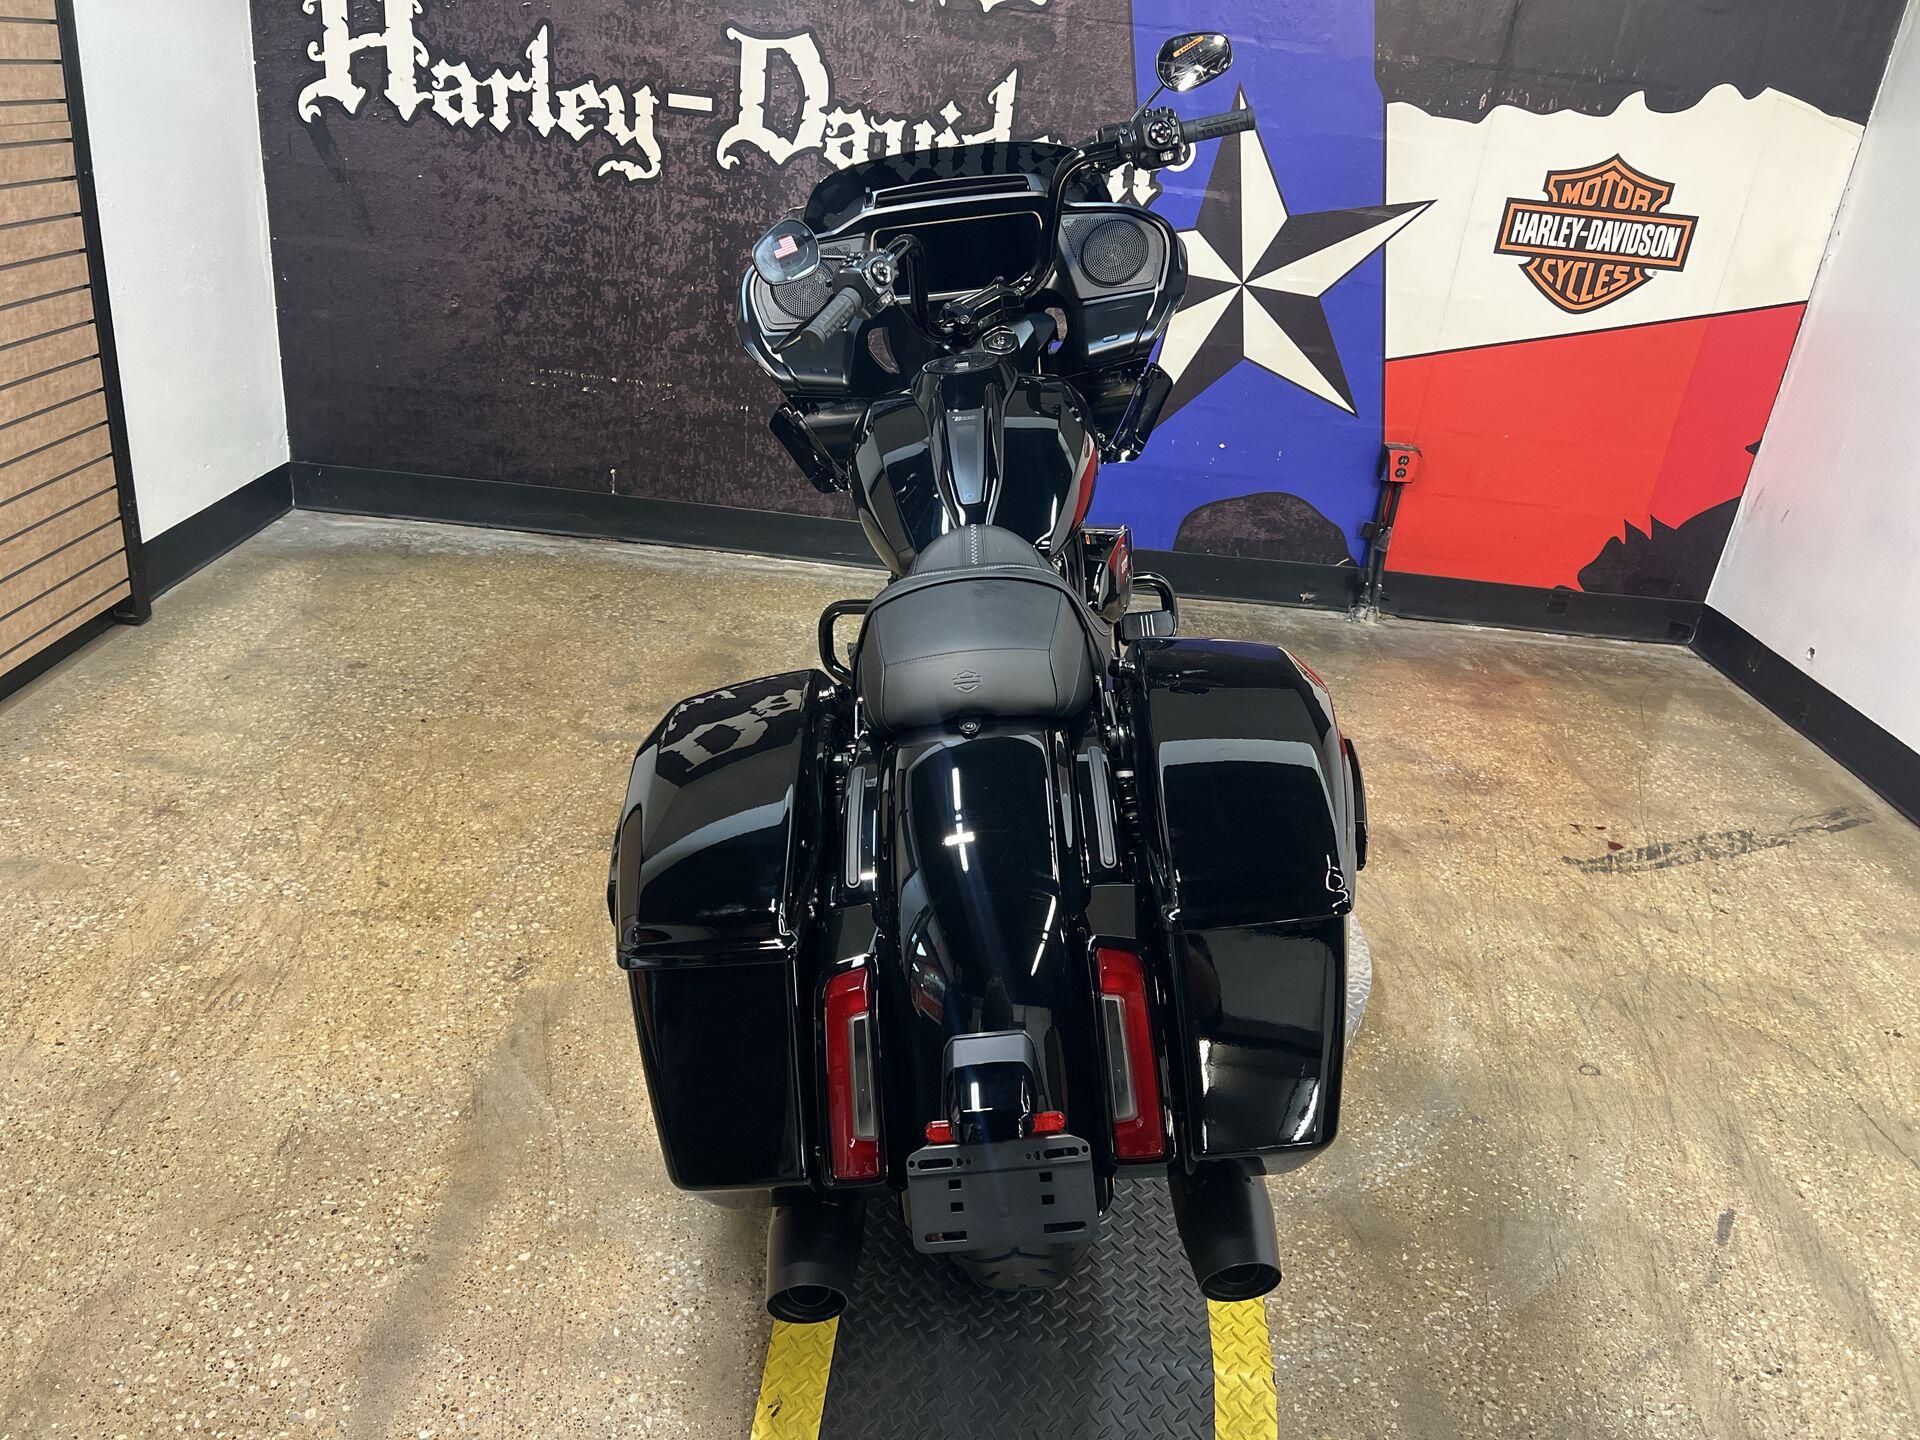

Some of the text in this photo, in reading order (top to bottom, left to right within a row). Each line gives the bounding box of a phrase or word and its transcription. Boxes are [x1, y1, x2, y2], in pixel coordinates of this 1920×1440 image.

[1561, 169, 1652, 213] MOTOR
[1510, 211, 1682, 259] HARLEY-DAVIDSON
[1541, 258, 1631, 303] CYCLES
